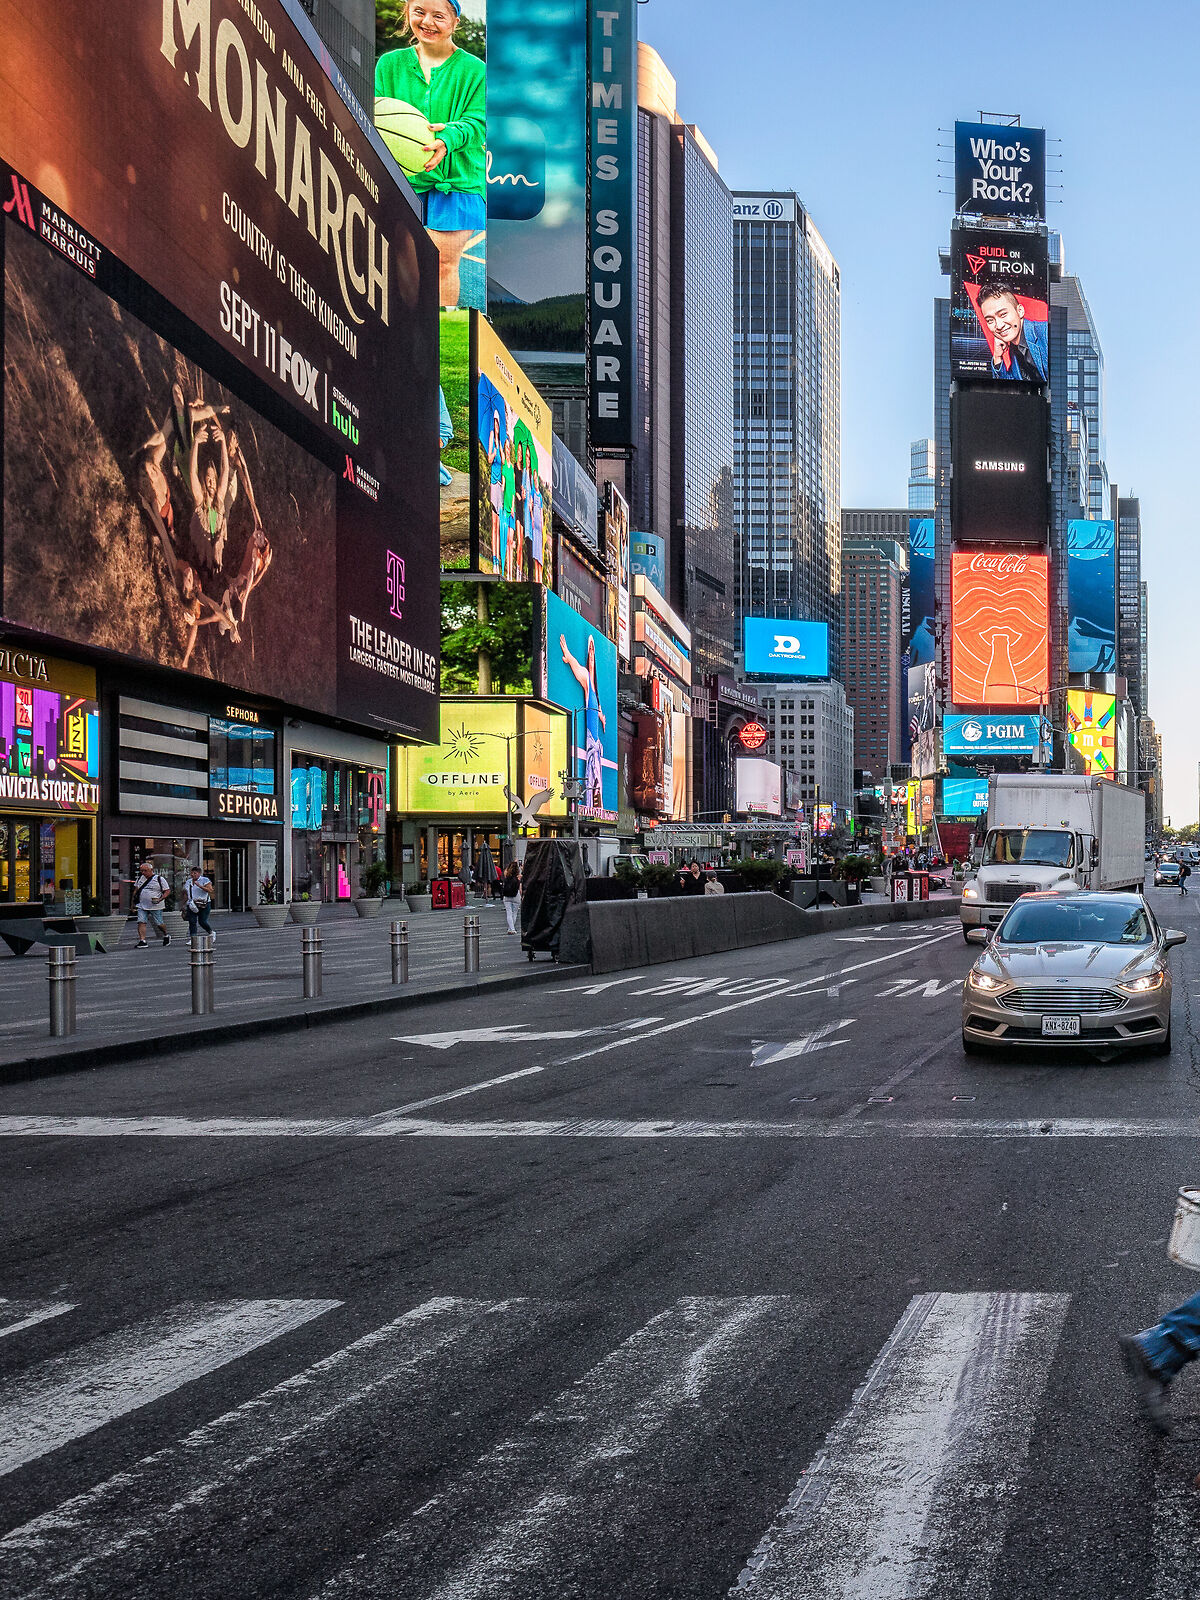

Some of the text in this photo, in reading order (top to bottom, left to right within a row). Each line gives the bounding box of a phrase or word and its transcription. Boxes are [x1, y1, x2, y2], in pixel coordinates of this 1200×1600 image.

[237, 0, 379, 204] ANDON ANNA FRIEL TRACE ADKINS
[592, 11, 623, 181] TIMES
[160, 0, 389, 326] MONARCH
[970, 137, 1031, 164] Who's
[978, 158, 1022, 182] Your
[972, 178, 1034, 204] Rock?
[41, 202, 102, 259] MARRIOTT
[41, 223, 96, 276] MARQUIS
[979, 246, 1021, 258] BUIDL ON
[222, 191, 358, 360] COUNTRY IS THEIR KINGDOM
[988, 259, 1035, 275] TRON
[592, 209, 623, 418] SQUARE
[220, 281, 319, 411] SEPT 11 FOX
[332, 400, 360, 445] hulu
[975, 461, 1026, 472] SAMSUNG
[349, 614, 436, 680] THE LEADER IN 5G
[349, 645, 377, 671] LARGEST.
[377, 658, 400, 681] FASTEST.
[400, 668, 414, 687] MOST
[226, 705, 259, 724] SEPHORA
[986, 724, 1026, 739] PGIM
[41, 778, 75, 802] STORE
[76, 783, 91, 804] AT
[428, 774, 500, 785] OFFLINE
[447, 789, 457, 797] by
[219, 793, 278, 817] SEPHORA
